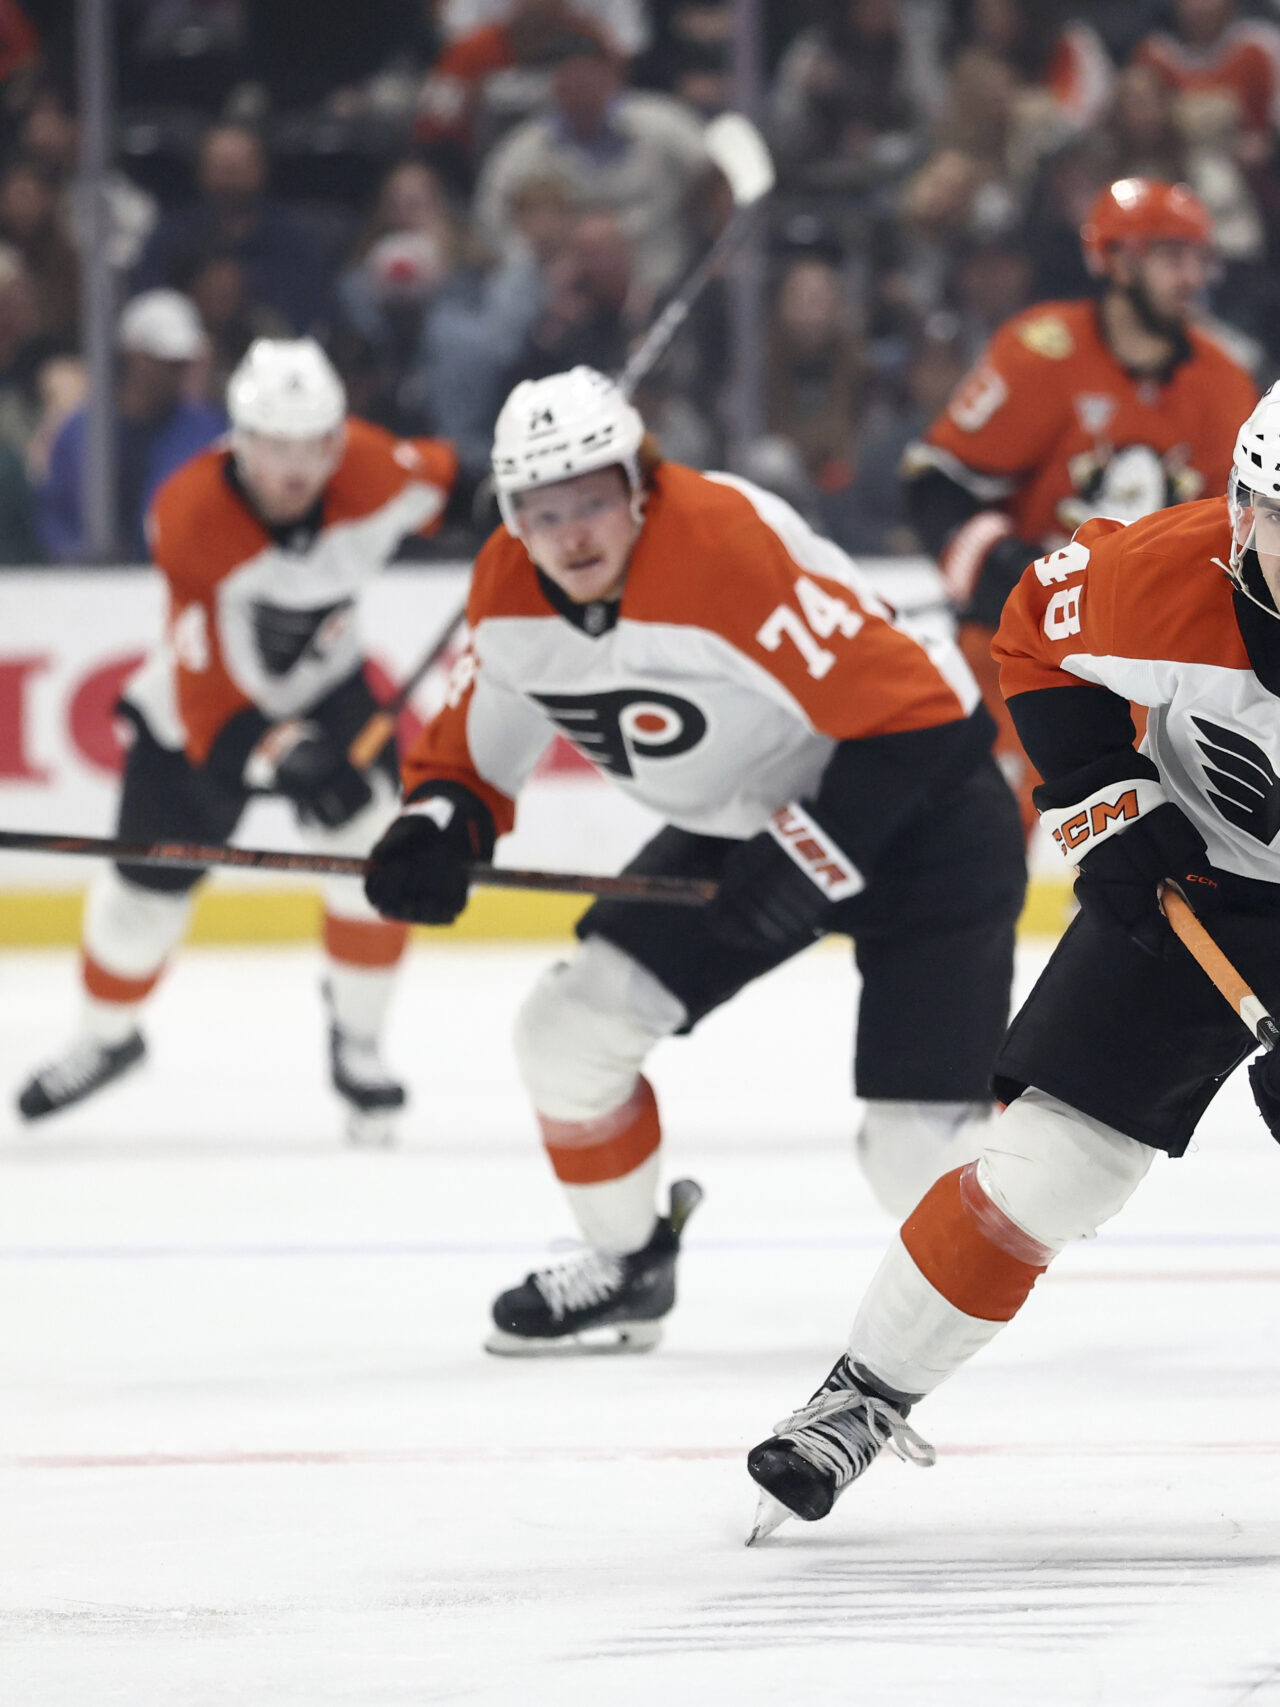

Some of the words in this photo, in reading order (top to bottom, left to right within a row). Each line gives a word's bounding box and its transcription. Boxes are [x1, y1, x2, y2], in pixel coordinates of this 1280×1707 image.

[756, 576, 865, 680] 74
[1034, 541, 1091, 641] 48
[1186, 874, 1219, 889] CCM
